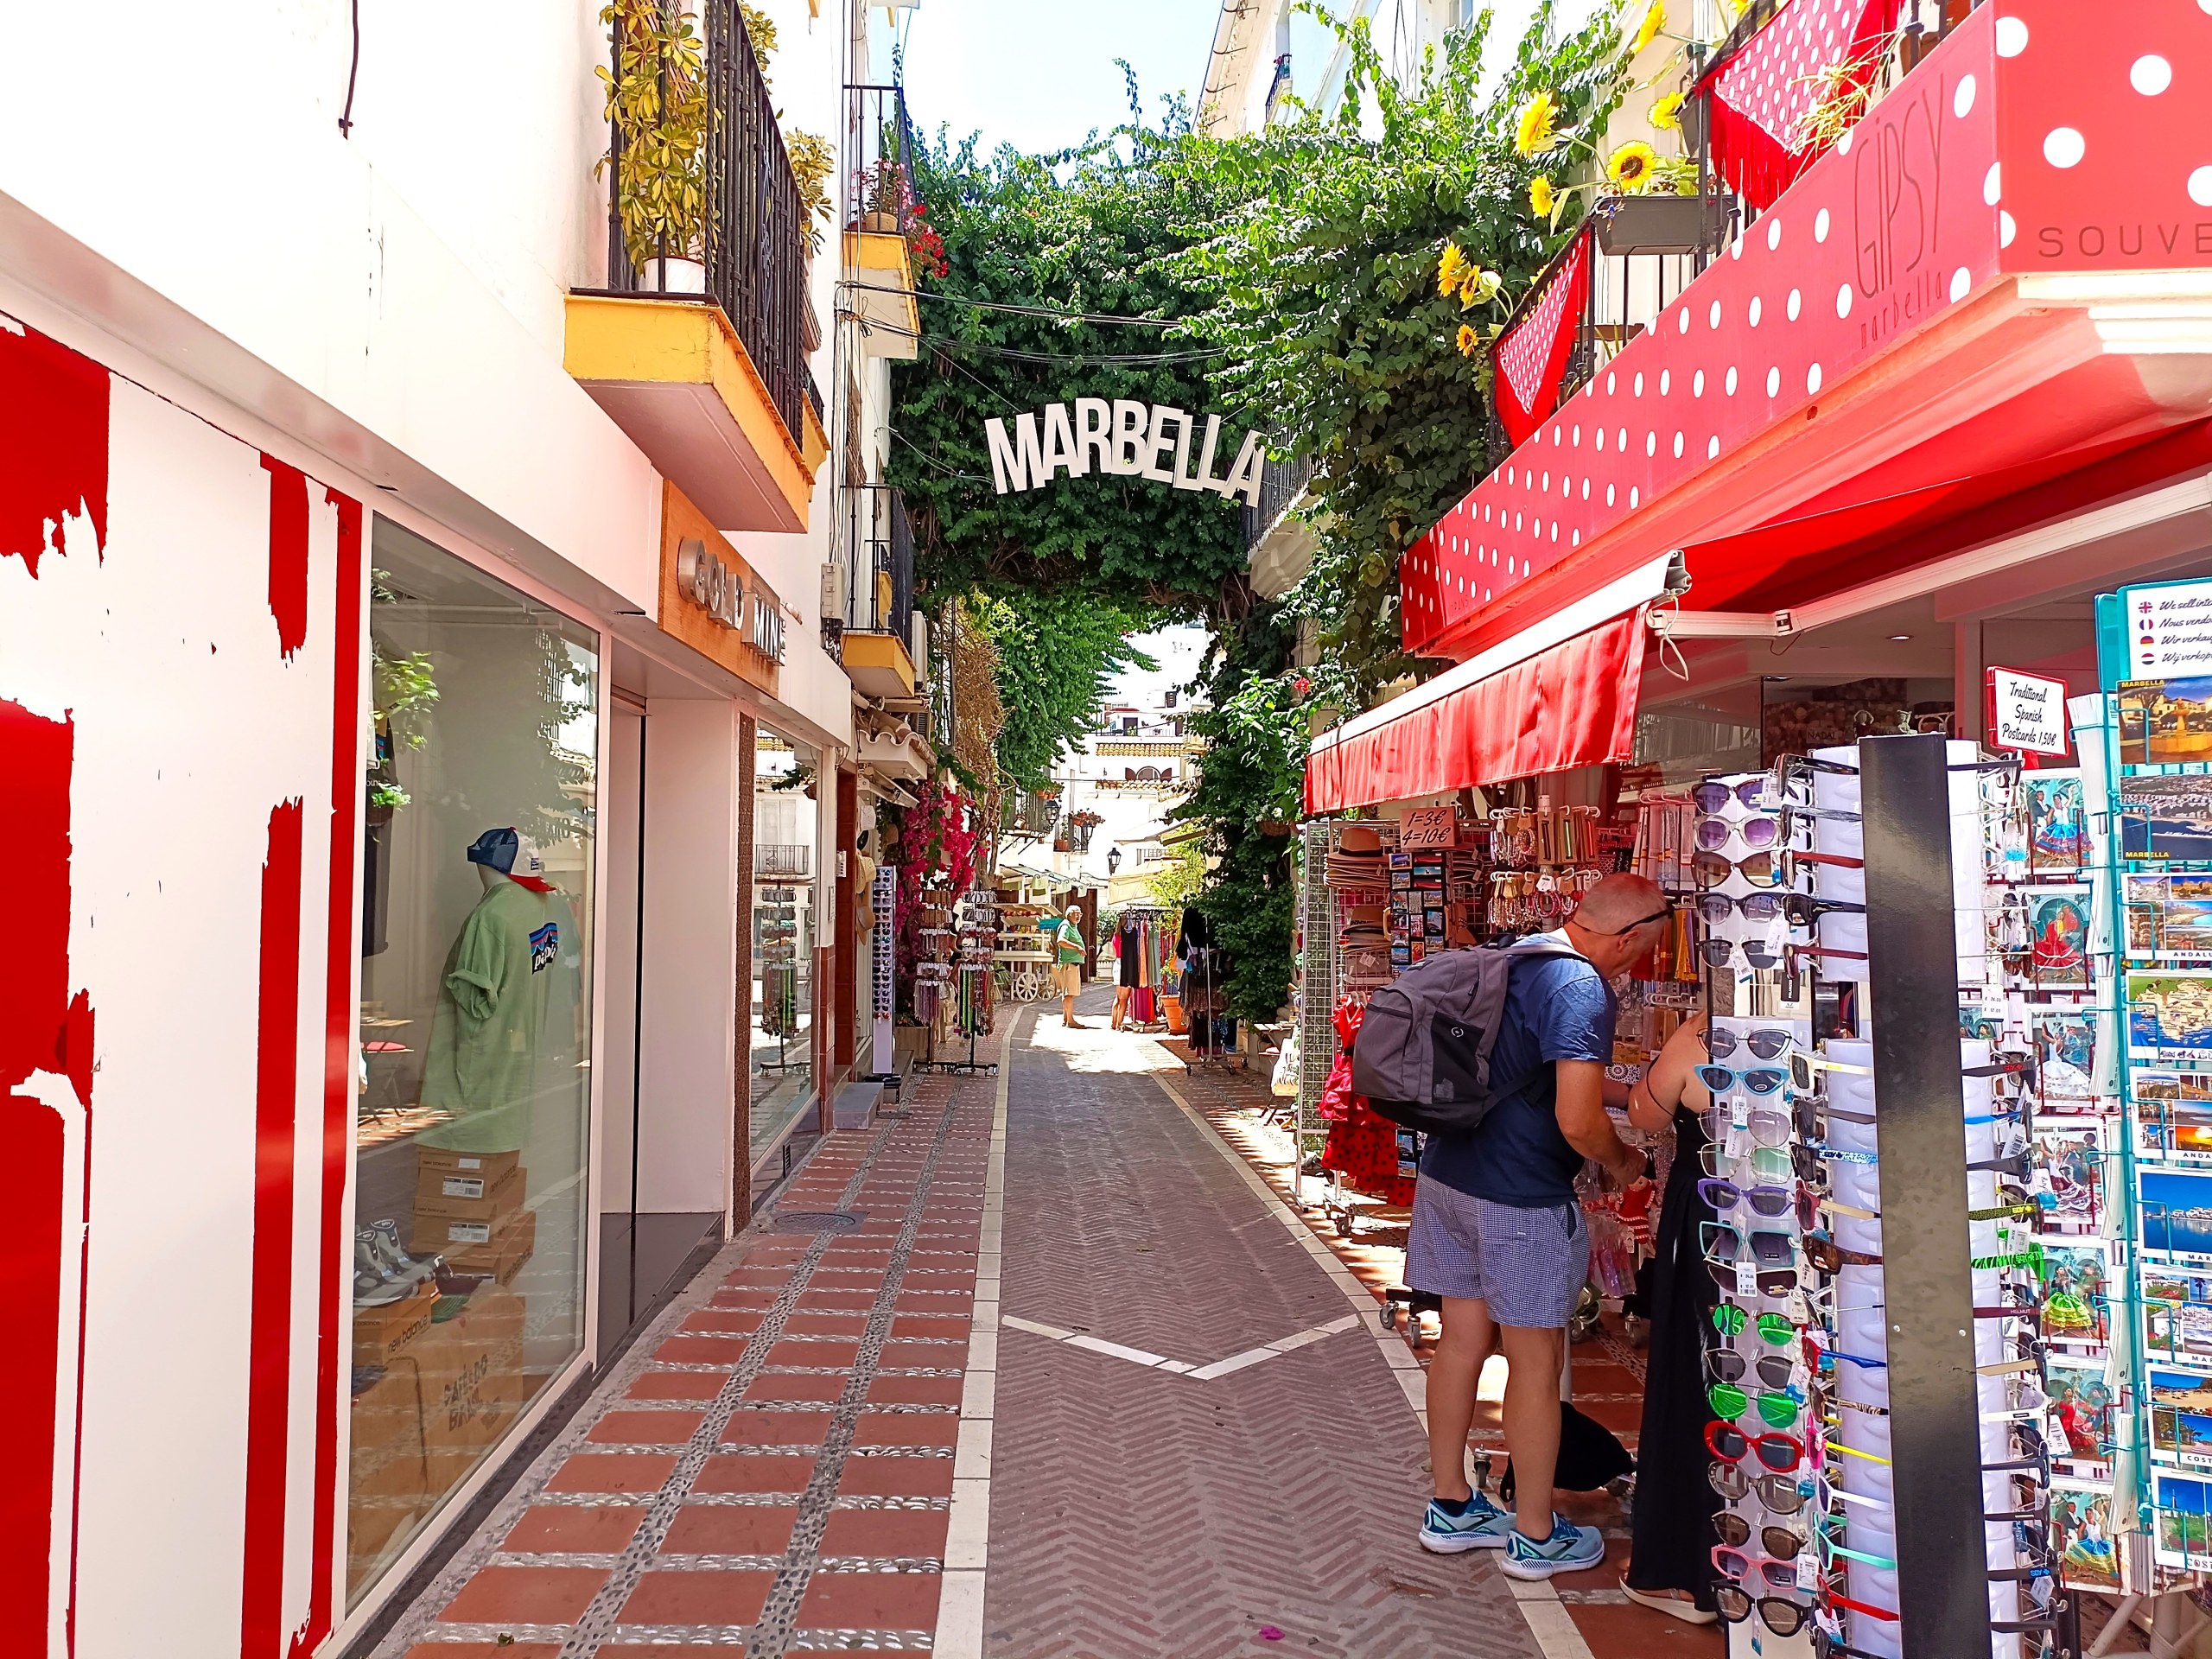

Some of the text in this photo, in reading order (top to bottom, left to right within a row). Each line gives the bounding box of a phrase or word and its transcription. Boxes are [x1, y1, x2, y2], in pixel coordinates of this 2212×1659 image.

[2037, 222, 2212, 258] SOUVE
[984, 397, 1266, 508] MARBELLA
[2159, 600, 2177, 611] We
[2177, 598, 2196, 609] sell
[2158, 617, 2184, 628] Nous
[2160, 632, 2212, 645] Wir verkau
[2161, 652, 2181, 665] Wij
[2010, 681, 2048, 702] Traditional
[2121, 679, 2164, 688] MARBELLA
[2014, 704, 2043, 724] Spanish
[2002, 722, 2057, 747] Postcards 1,50€
[1408, 810, 1447, 827] 1=3€
[1402, 827, 1452, 846] 4=10€
[387, 1313, 429, 1356] new balance
